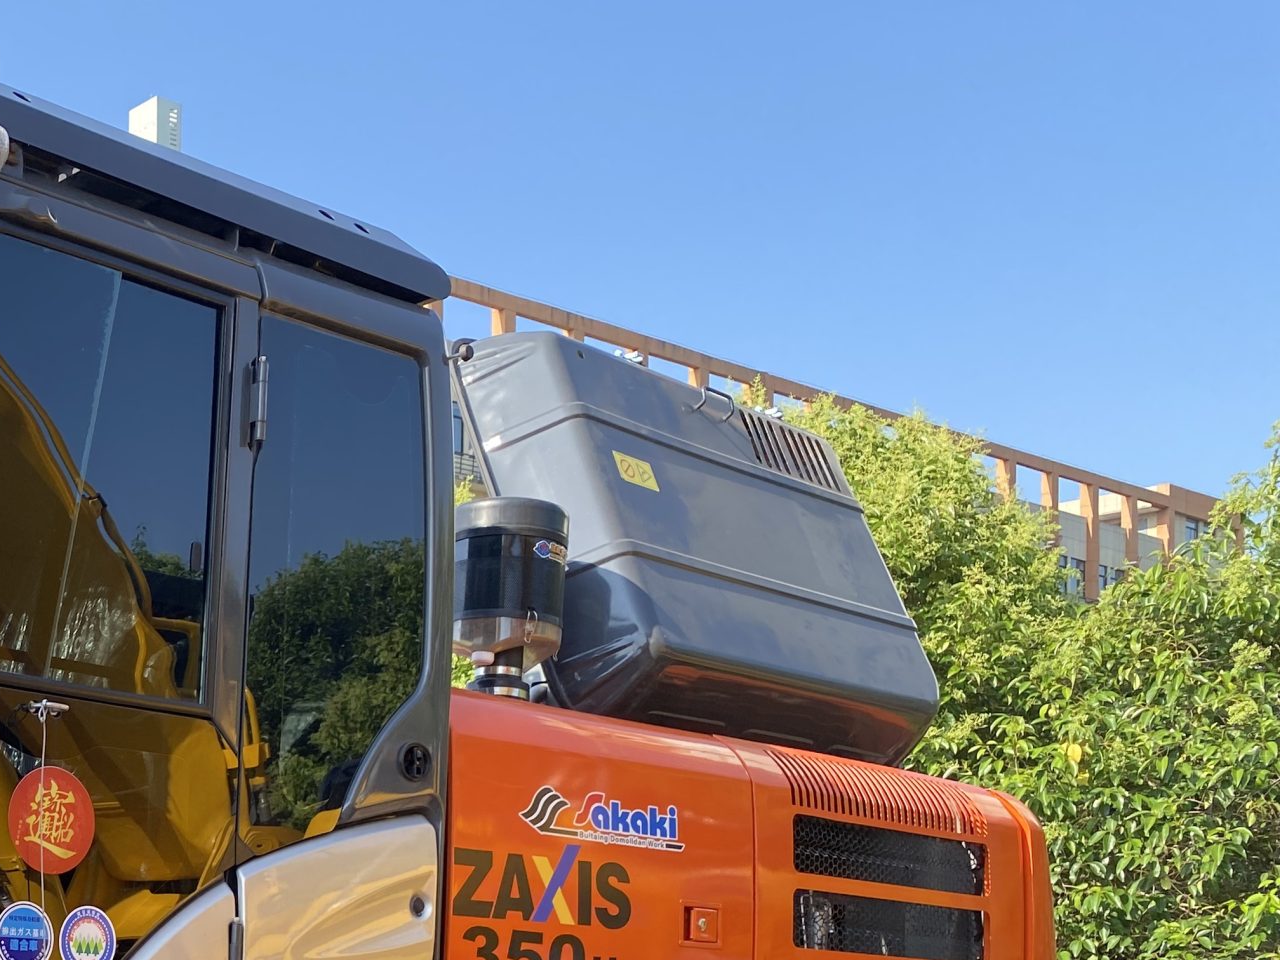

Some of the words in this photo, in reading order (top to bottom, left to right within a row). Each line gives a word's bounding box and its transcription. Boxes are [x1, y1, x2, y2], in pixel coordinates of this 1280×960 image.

[574, 792, 677, 839] Sakaki
[647, 839, 665, 849] Work
[453, 844, 632, 930] ZAXIS
